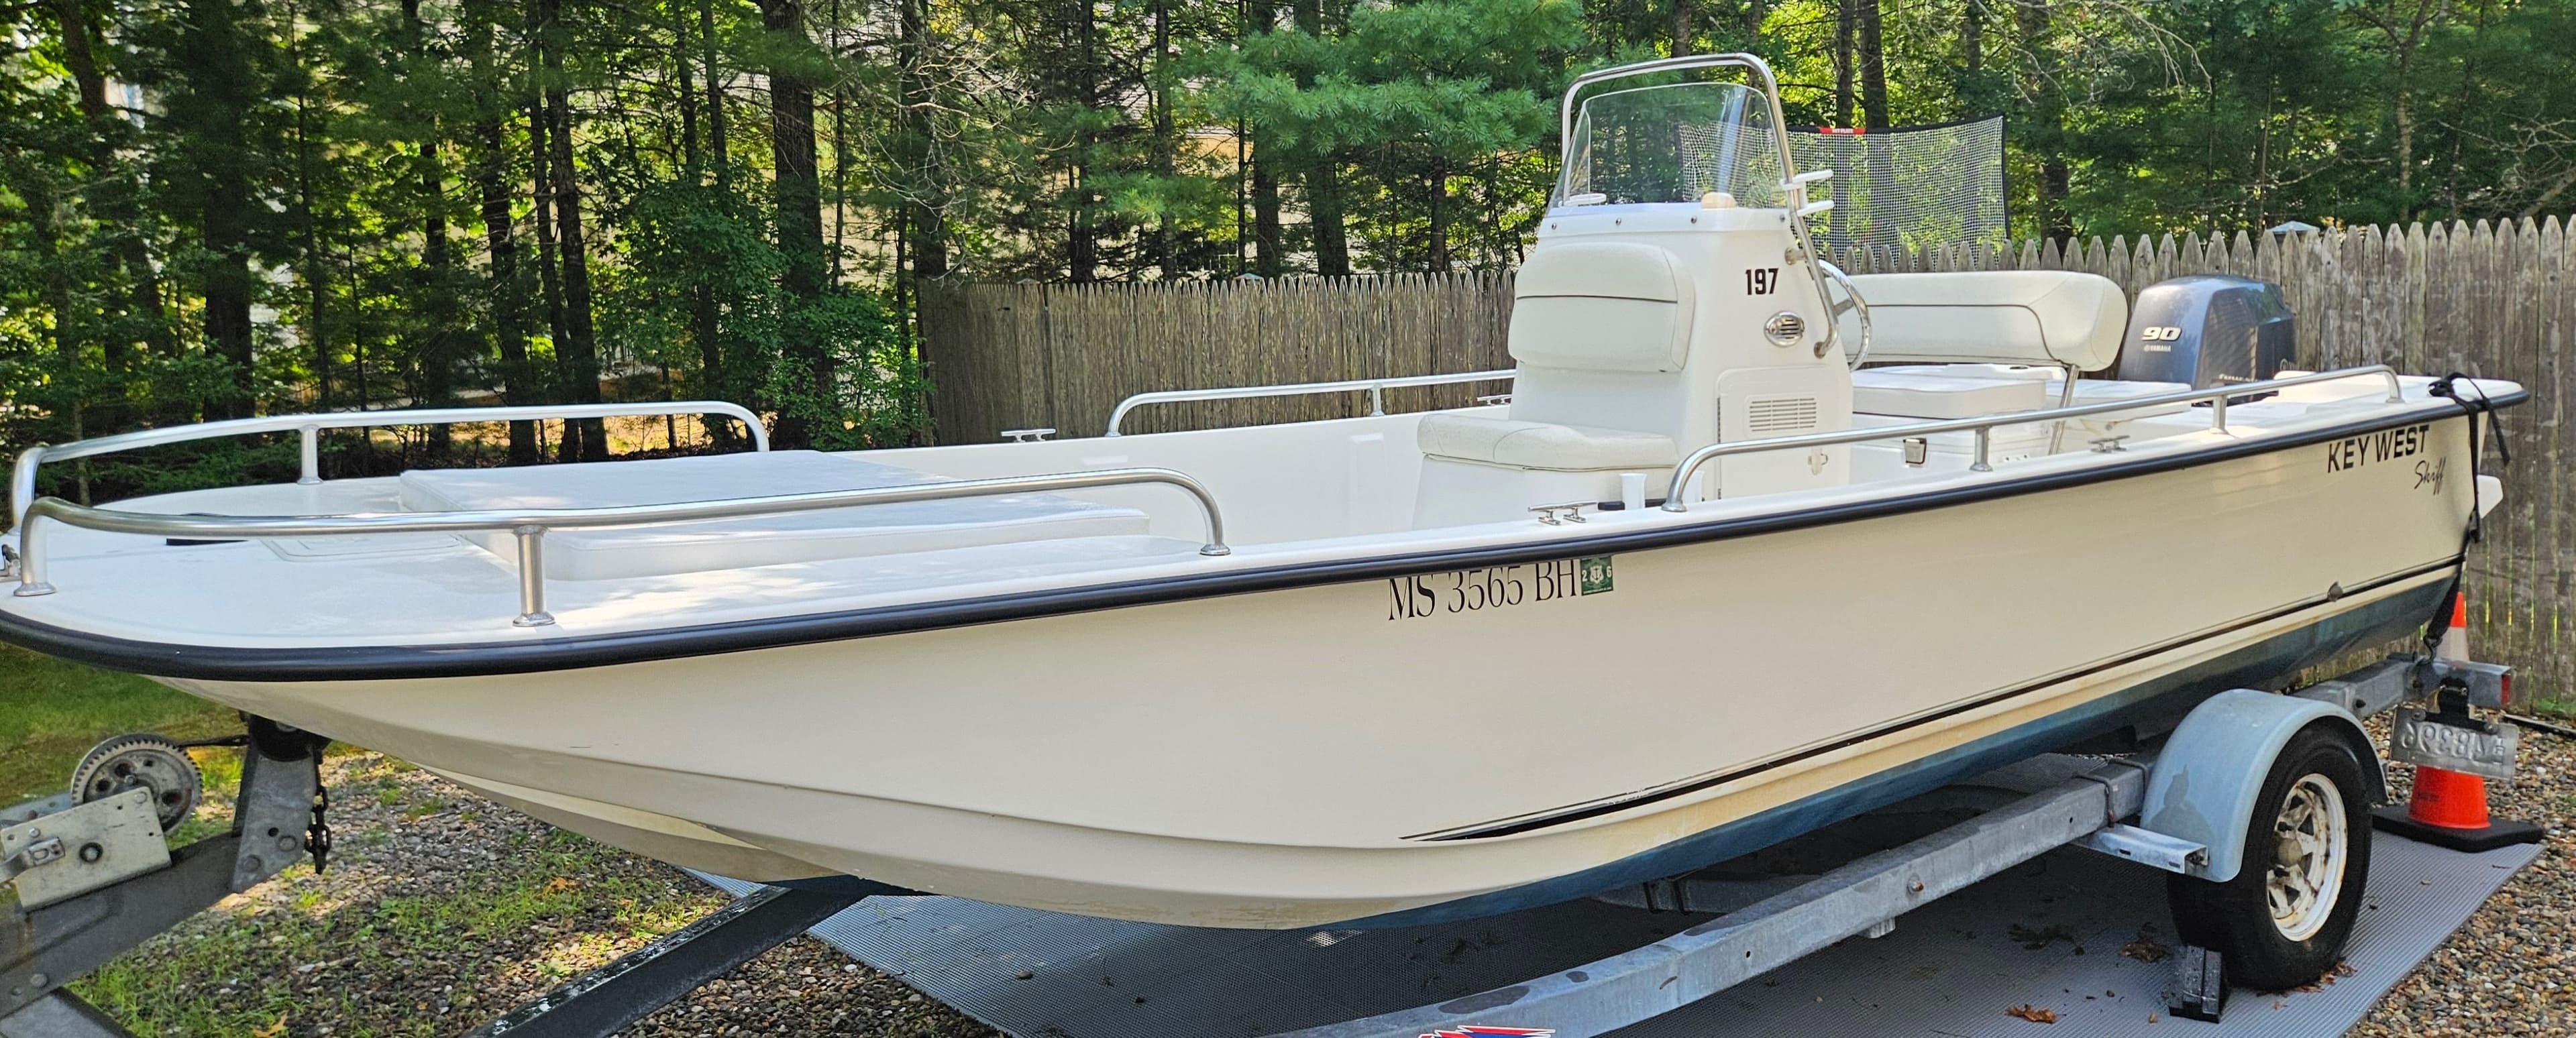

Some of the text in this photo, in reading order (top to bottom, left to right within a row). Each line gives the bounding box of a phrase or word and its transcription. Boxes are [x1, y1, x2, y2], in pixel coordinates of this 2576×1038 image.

[1745, 268, 1779, 296] 197
[2141, 327, 2182, 341] 90
[2327, 424, 2430, 473] KEY WEST
[2414, 456, 2447, 496] Skiff
[1389, 559, 1576, 621] MS 3565 BH
